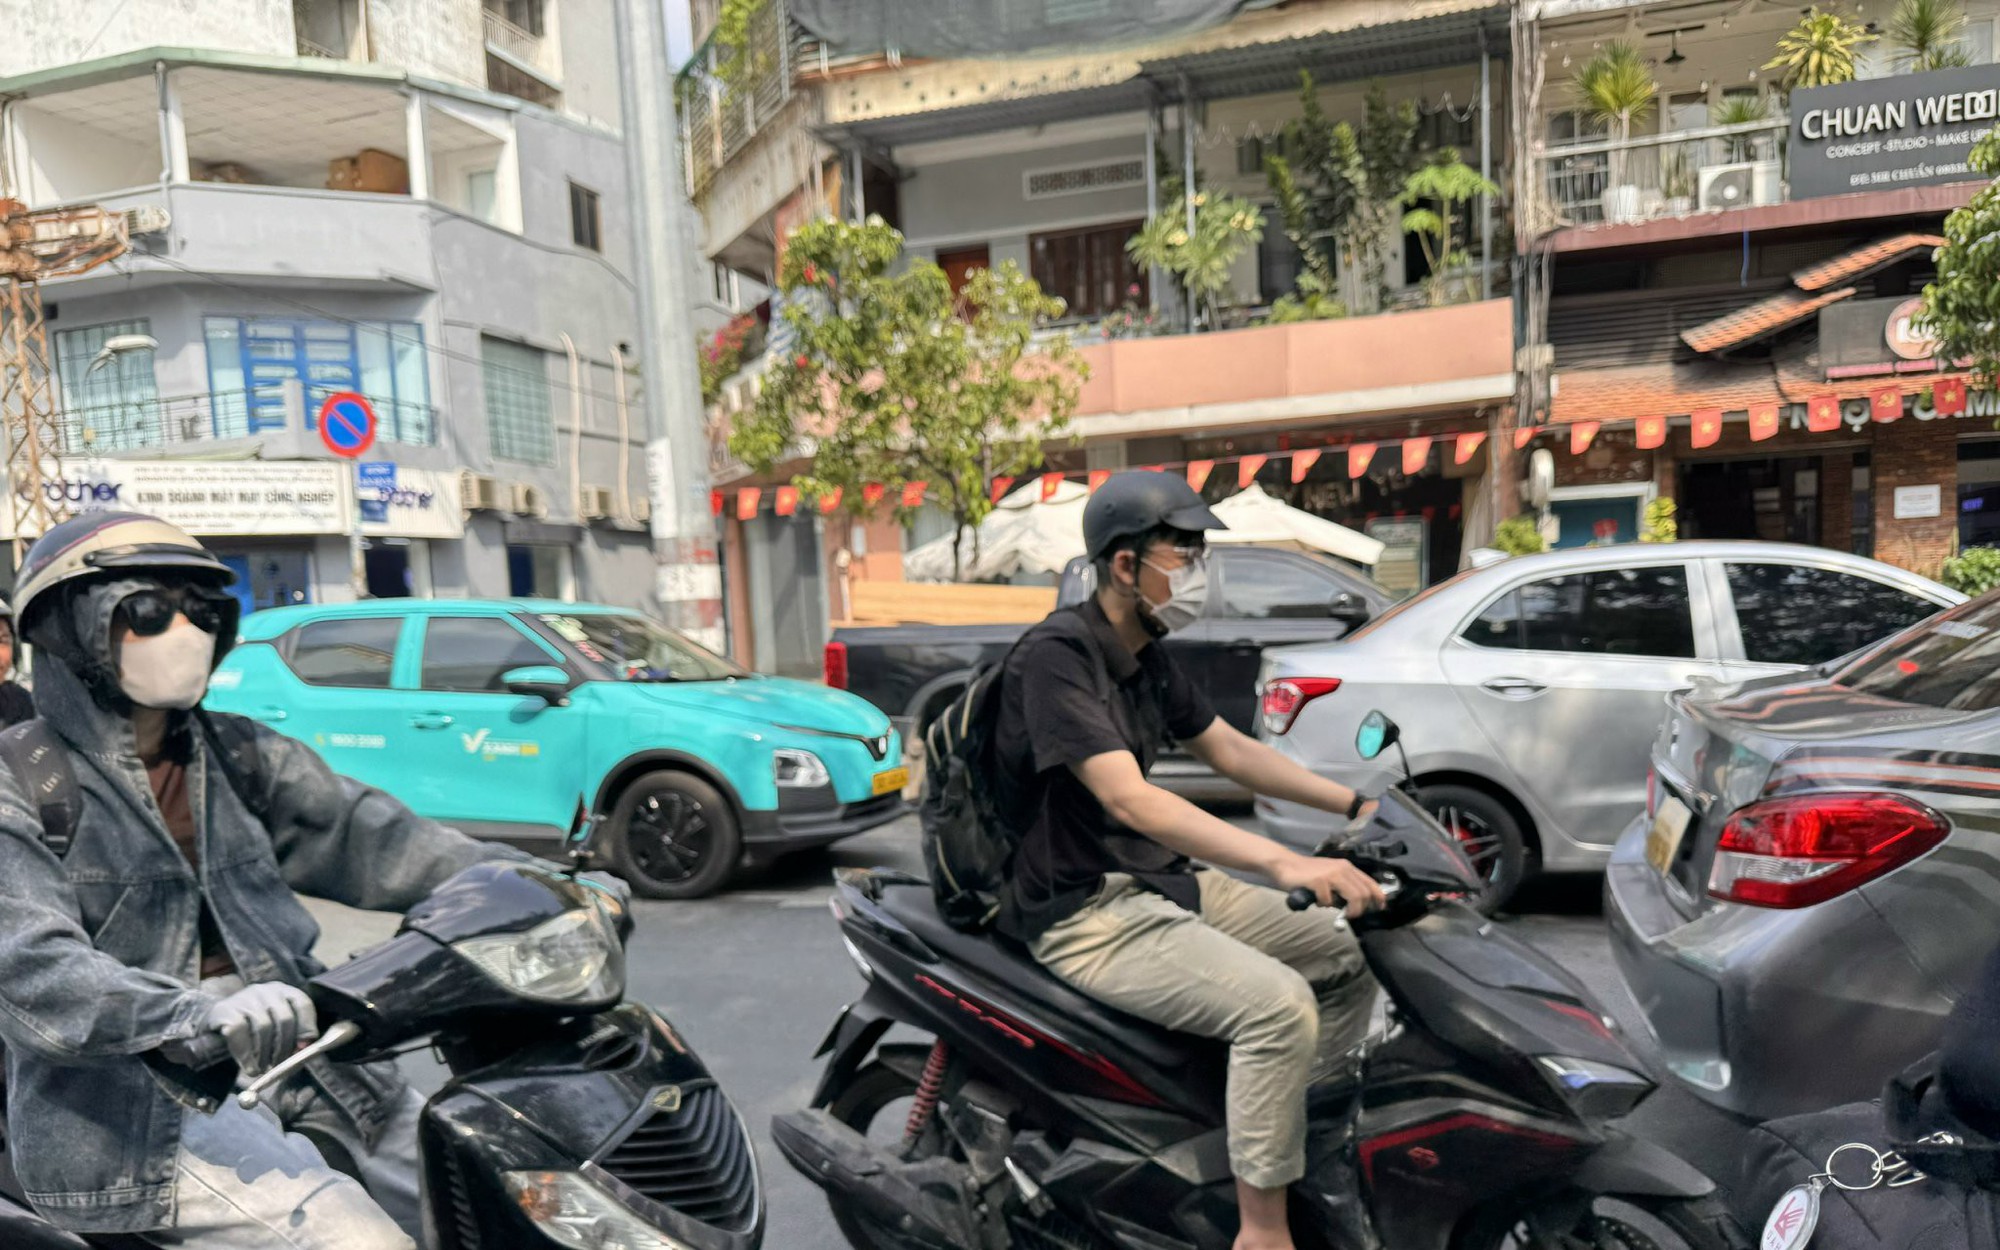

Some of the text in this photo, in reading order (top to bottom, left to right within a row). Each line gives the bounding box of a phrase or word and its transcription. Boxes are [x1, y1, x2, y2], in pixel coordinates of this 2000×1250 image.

[1801, 88, 2000, 139] CHUAN WEDD
[1825, 140, 1881, 159] CONCEPT
[1935, 129, 1970, 147] MAKE
[16, 476, 123, 502] other
